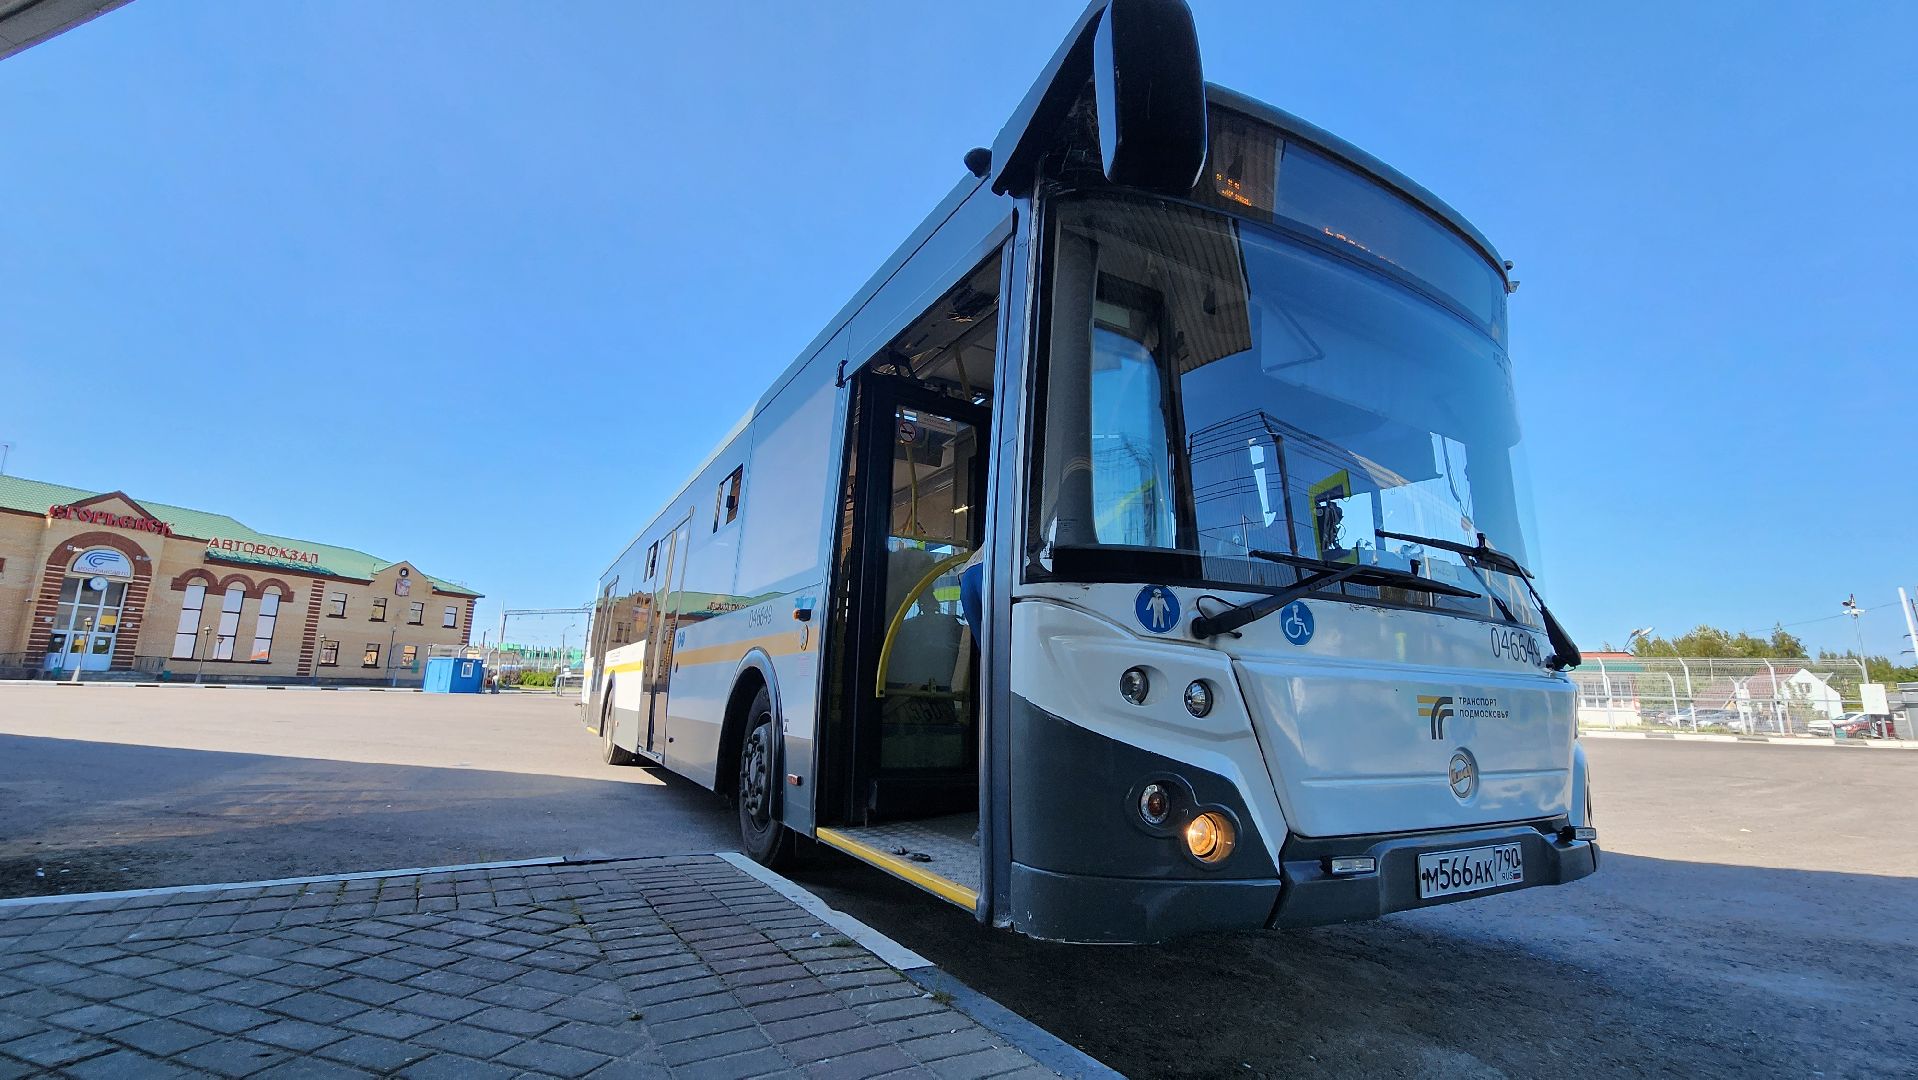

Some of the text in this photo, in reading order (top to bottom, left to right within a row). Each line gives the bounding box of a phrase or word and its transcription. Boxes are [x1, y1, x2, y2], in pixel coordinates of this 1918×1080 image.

[207, 537, 319, 563] АВТОВОКЗАЛ
[1490, 627, 1542, 667] 046649
[1459, 696, 1497, 707] ТРАНСПОРТ
[1459, 709, 1509, 719] ПОДМОСКОВЬЯ
[1502, 872, 1514, 881] RUS
